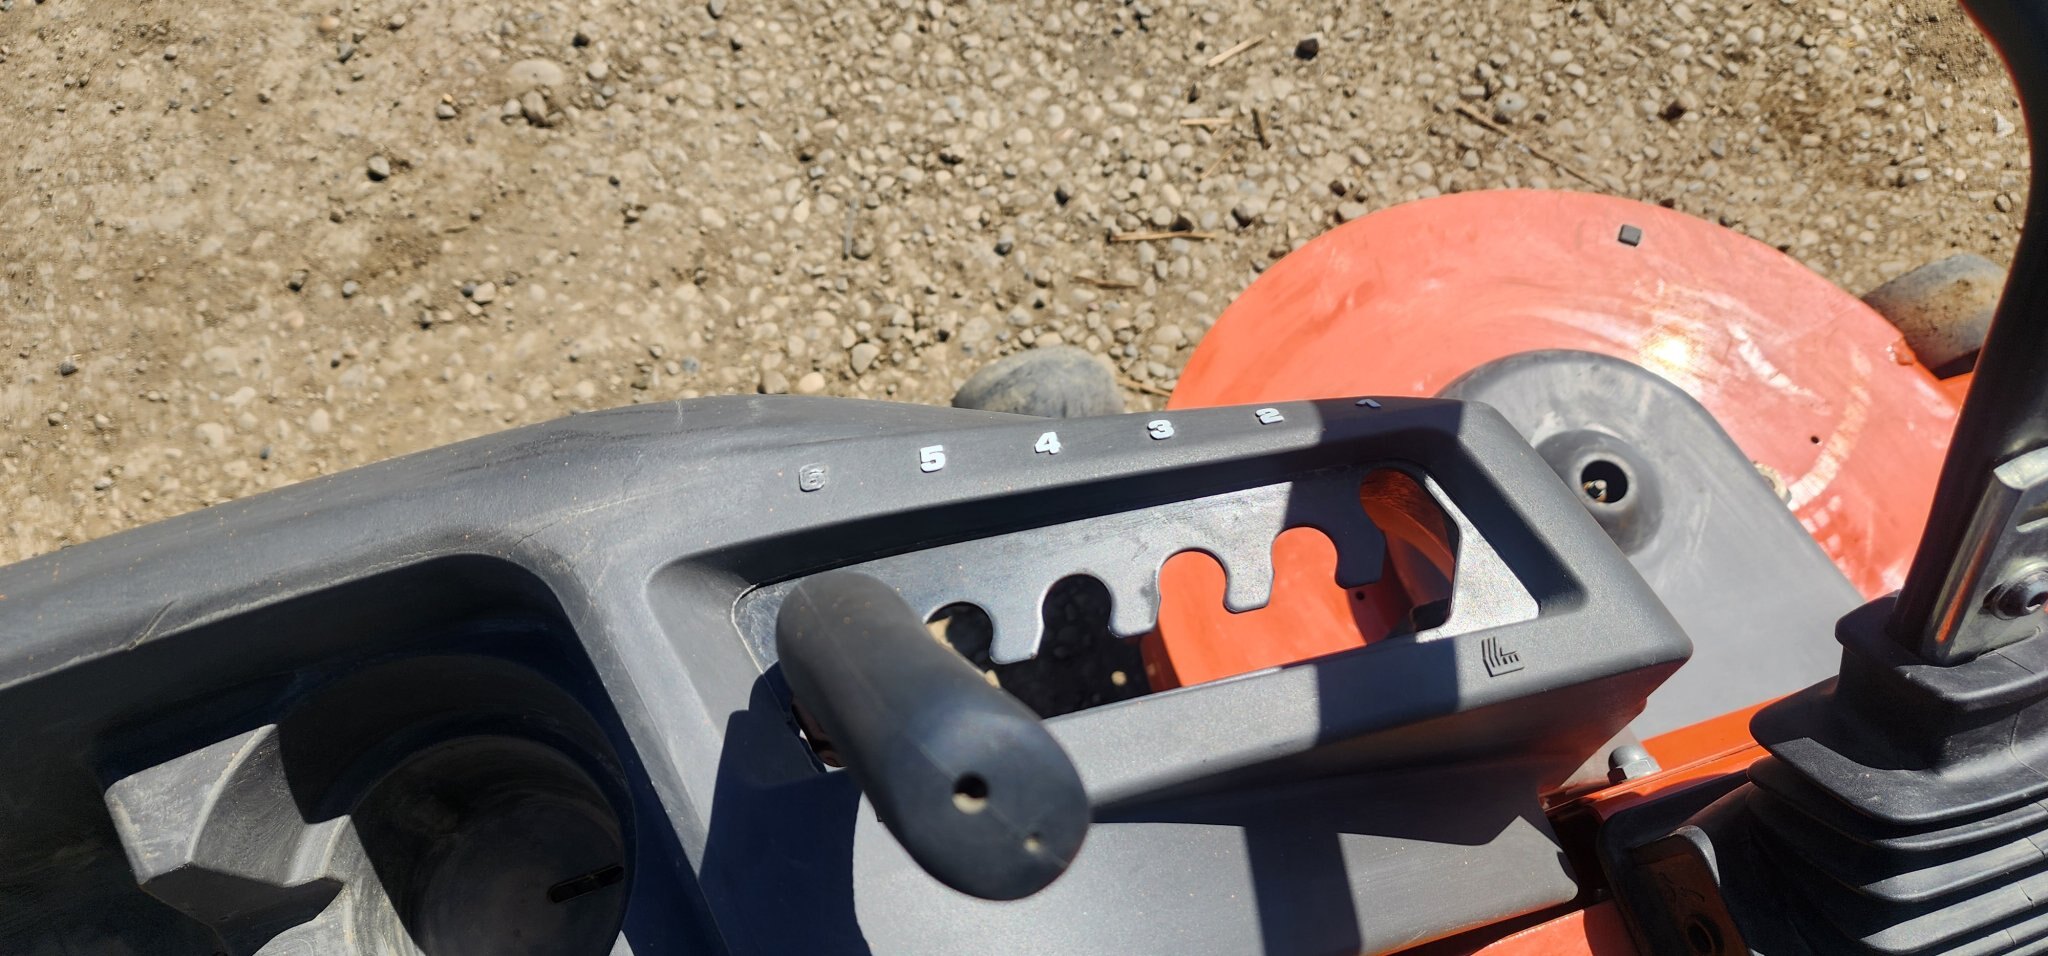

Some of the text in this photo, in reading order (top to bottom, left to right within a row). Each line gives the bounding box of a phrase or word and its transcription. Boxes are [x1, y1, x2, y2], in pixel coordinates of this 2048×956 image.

[799, 463, 826, 492] 6
[920, 444, 946, 473] 5
[1034, 431, 1062, 455] 4
[1147, 419, 1175, 440] 3
[1255, 407, 1285, 425] 2
